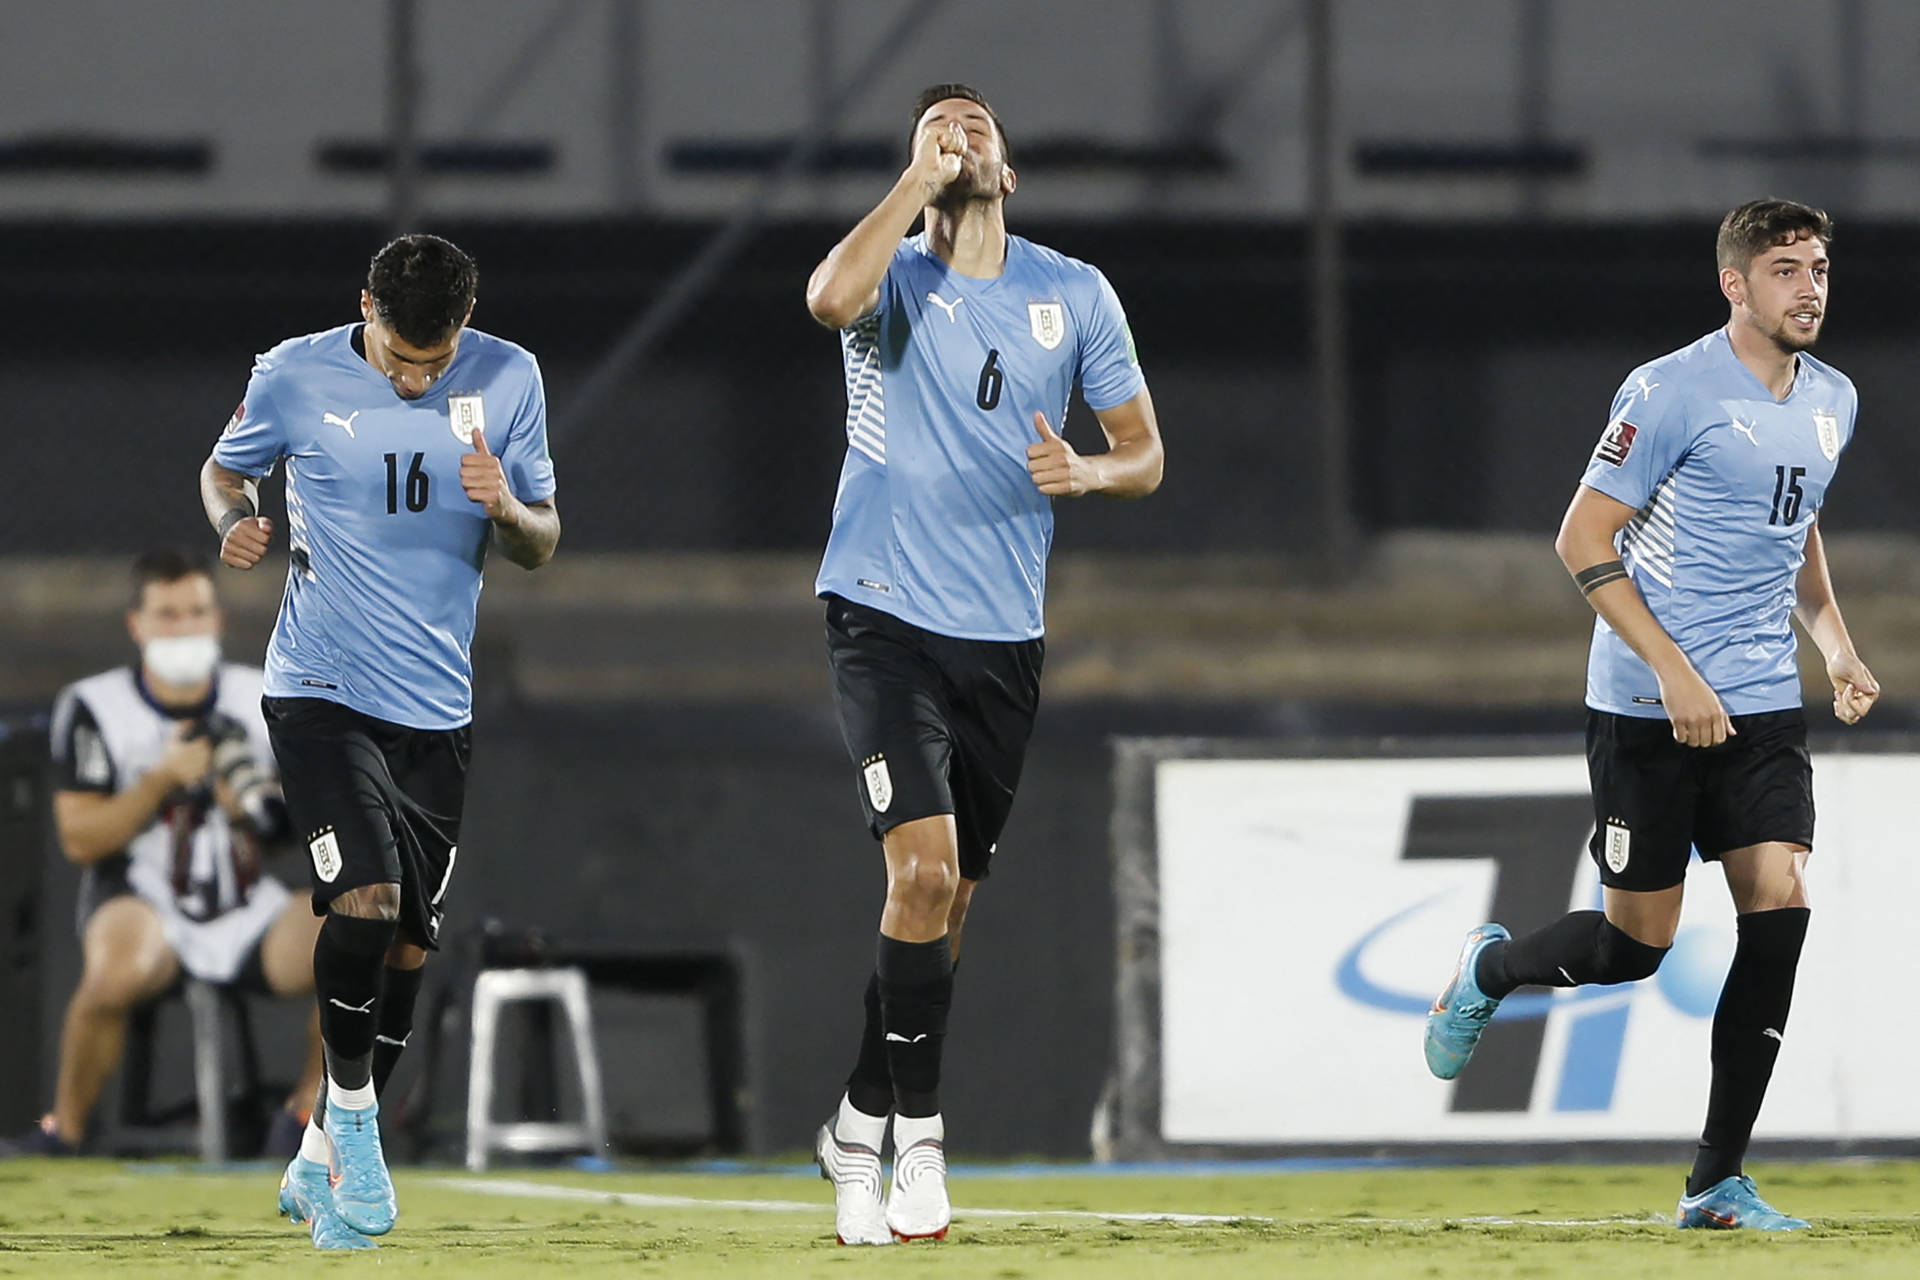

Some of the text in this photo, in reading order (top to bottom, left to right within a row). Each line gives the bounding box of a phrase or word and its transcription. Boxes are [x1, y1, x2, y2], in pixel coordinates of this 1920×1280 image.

[976, 349, 1003, 411] 6
[383, 452, 430, 515] 16
[1768, 465, 1806, 527] 15
